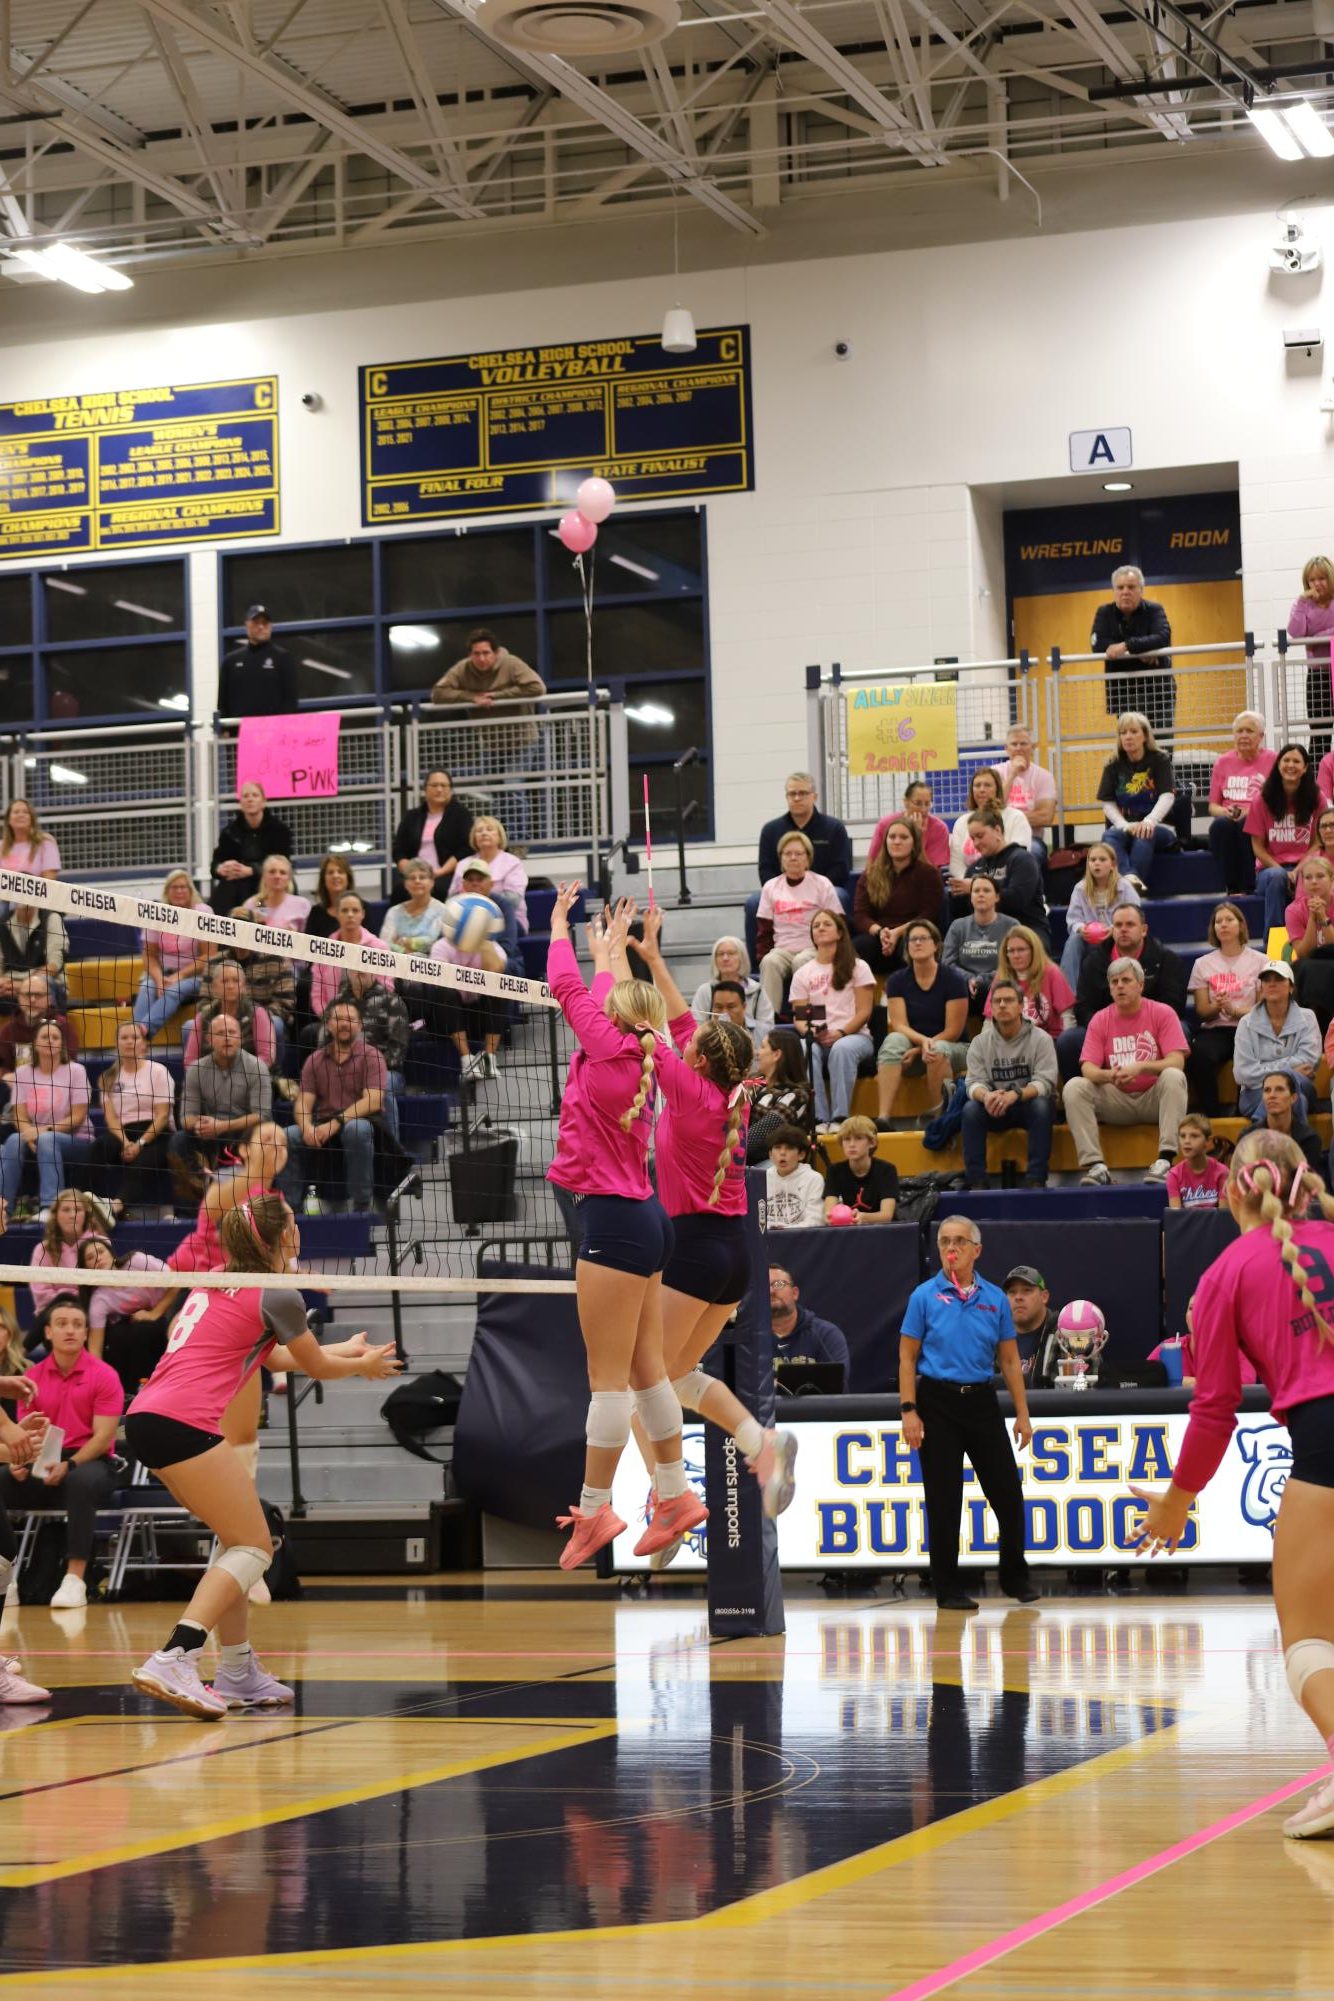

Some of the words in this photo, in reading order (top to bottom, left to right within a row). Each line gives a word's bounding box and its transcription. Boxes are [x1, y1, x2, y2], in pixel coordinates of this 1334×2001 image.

[468, 351, 536, 369] CHELSEA
[540, 346, 574, 363] HIGH
[578, 341, 635, 358] SCHOOL
[720, 338, 736, 360] C
[481, 356, 626, 385] VOLLEYBALL
[672, 374, 736, 388] CHAMPIONS
[254, 384, 272, 408] C
[371, 372, 387, 395] C
[14, 396, 80, 416] CHELSEA
[81, 391, 116, 409] HIGH
[118, 387, 175, 406] SCHOOL
[53, 405, 135, 430] TENNIS
[1088, 434, 1116, 465] A
[593, 464, 638, 477] STATE
[641, 457, 707, 473] FINALIST
[420, 479, 460, 494] FINAL
[465, 476, 504, 490] FOUR
[110, 506, 178, 524] REGIONAL
[181, 499, 265, 517] CHAMPIONS
[1, 516, 82, 533] CHAMPIONS
[1021, 538, 1123, 561] WRESTLING
[1170, 529, 1230, 549] ROOM
[853, 687, 905, 710] ALLY
[876, 717, 917, 742] #6
[1227, 775, 1249, 788] DIG
[1268, 828, 1297, 842] PINK
[1, 874, 47, 898] CHELSEA
[71, 889, 117, 913] CHELSEA
[138, 903, 179, 926] CHELSEA
[198, 915, 237, 937] CHELSEA
[255, 927, 293, 949] CHELSEA
[310, 939, 346, 959] CHELSEA
[361, 950, 396, 969] CHELSEA
[410, 959, 442, 977] CHELSEA
[456, 968, 486, 987] CHELSEA
[1112, 1035, 1136, 1053] DIG
[166, 1292, 209, 1353] 8
[723, 1436, 740, 1487] sports
[833, 1423, 1176, 1488] CHSEA
[725, 1488, 740, 1548] imports
[714, 1607, 756, 1616] (800)556-3198
